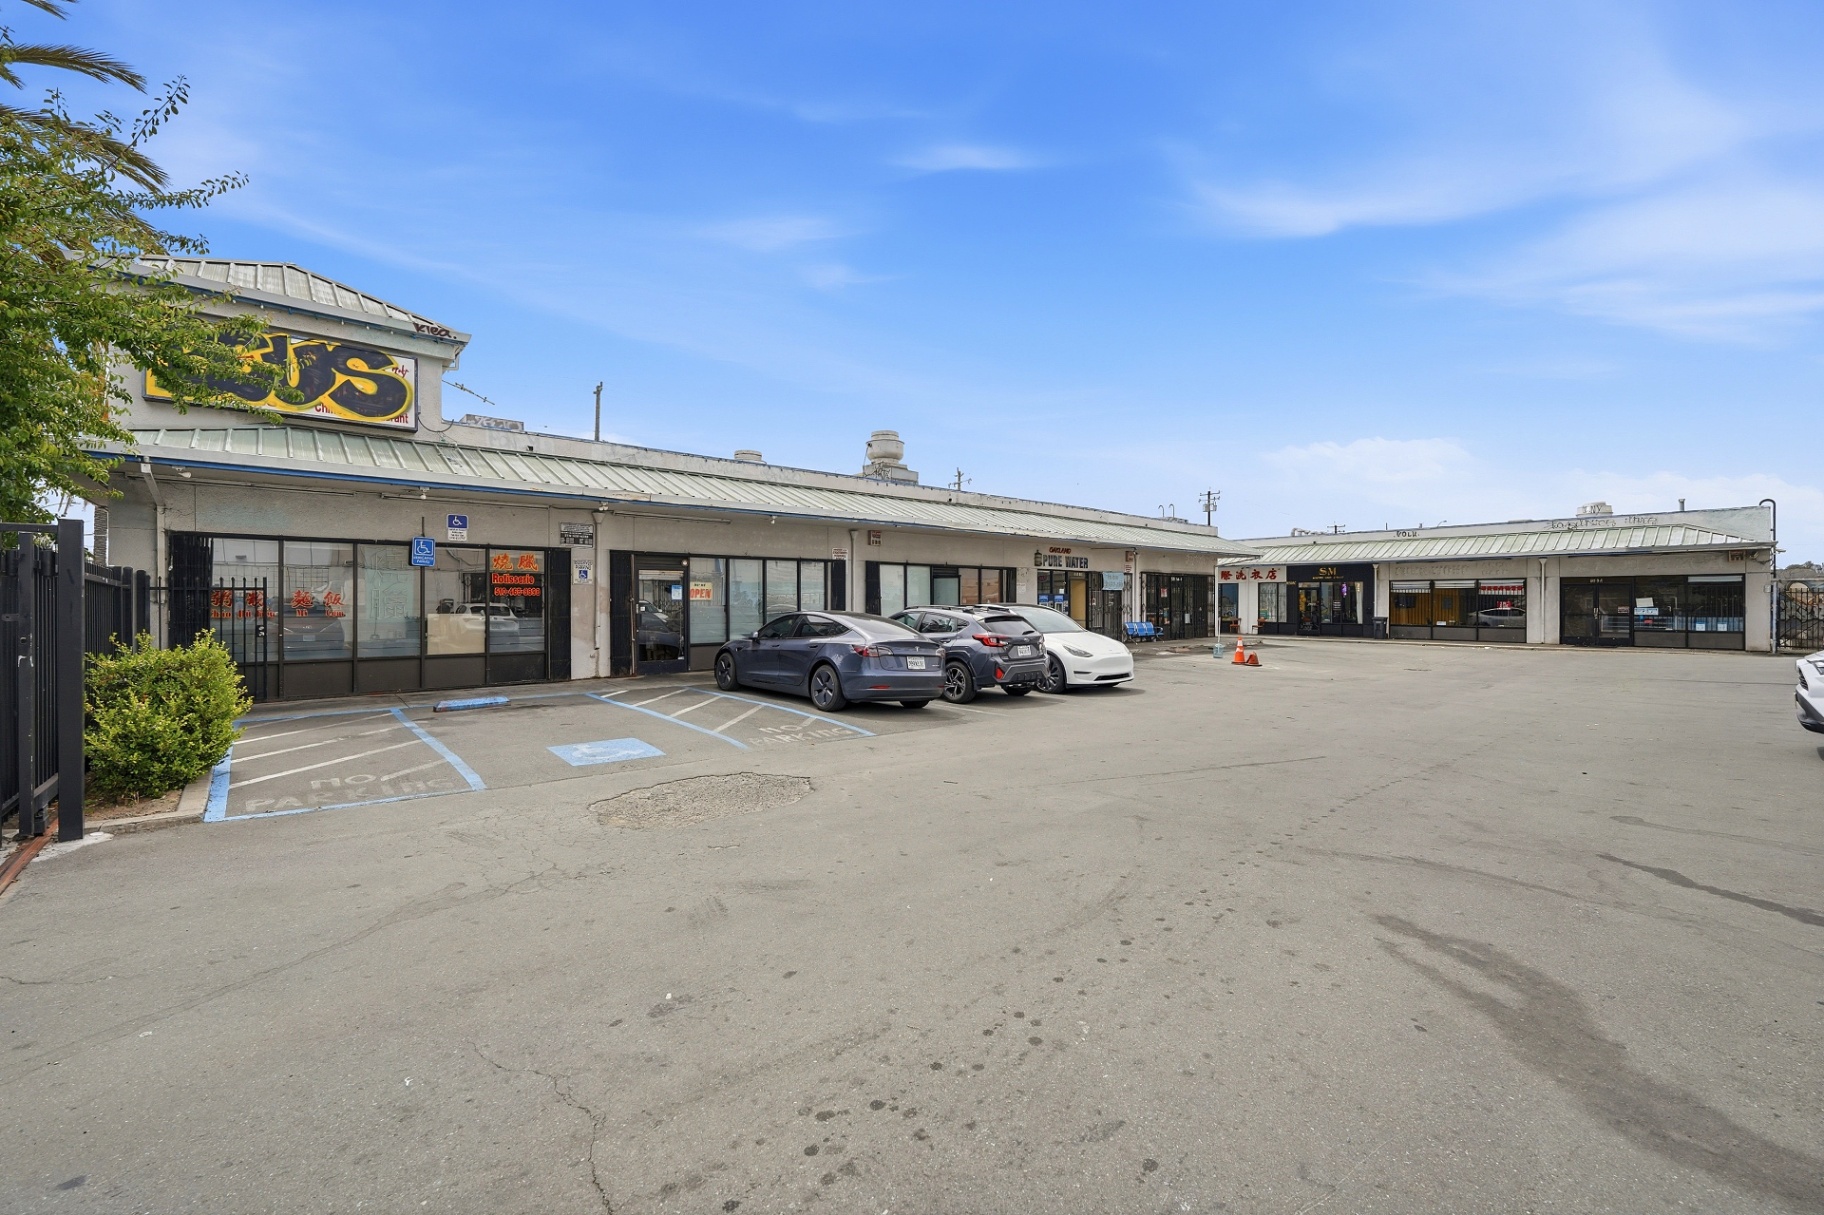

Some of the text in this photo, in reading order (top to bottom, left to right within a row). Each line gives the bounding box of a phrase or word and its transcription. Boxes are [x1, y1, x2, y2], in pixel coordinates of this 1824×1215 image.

[1042, 554, 1089, 569] PURE WATER
[1318, 567, 1337, 576] SM
[690, 588, 712, 599] OPEN
[747, 727, 854, 745] PARKING
[759, 724, 802, 734] NO
[311, 774, 377, 789] NO
[245, 778, 455, 812] PARKING
